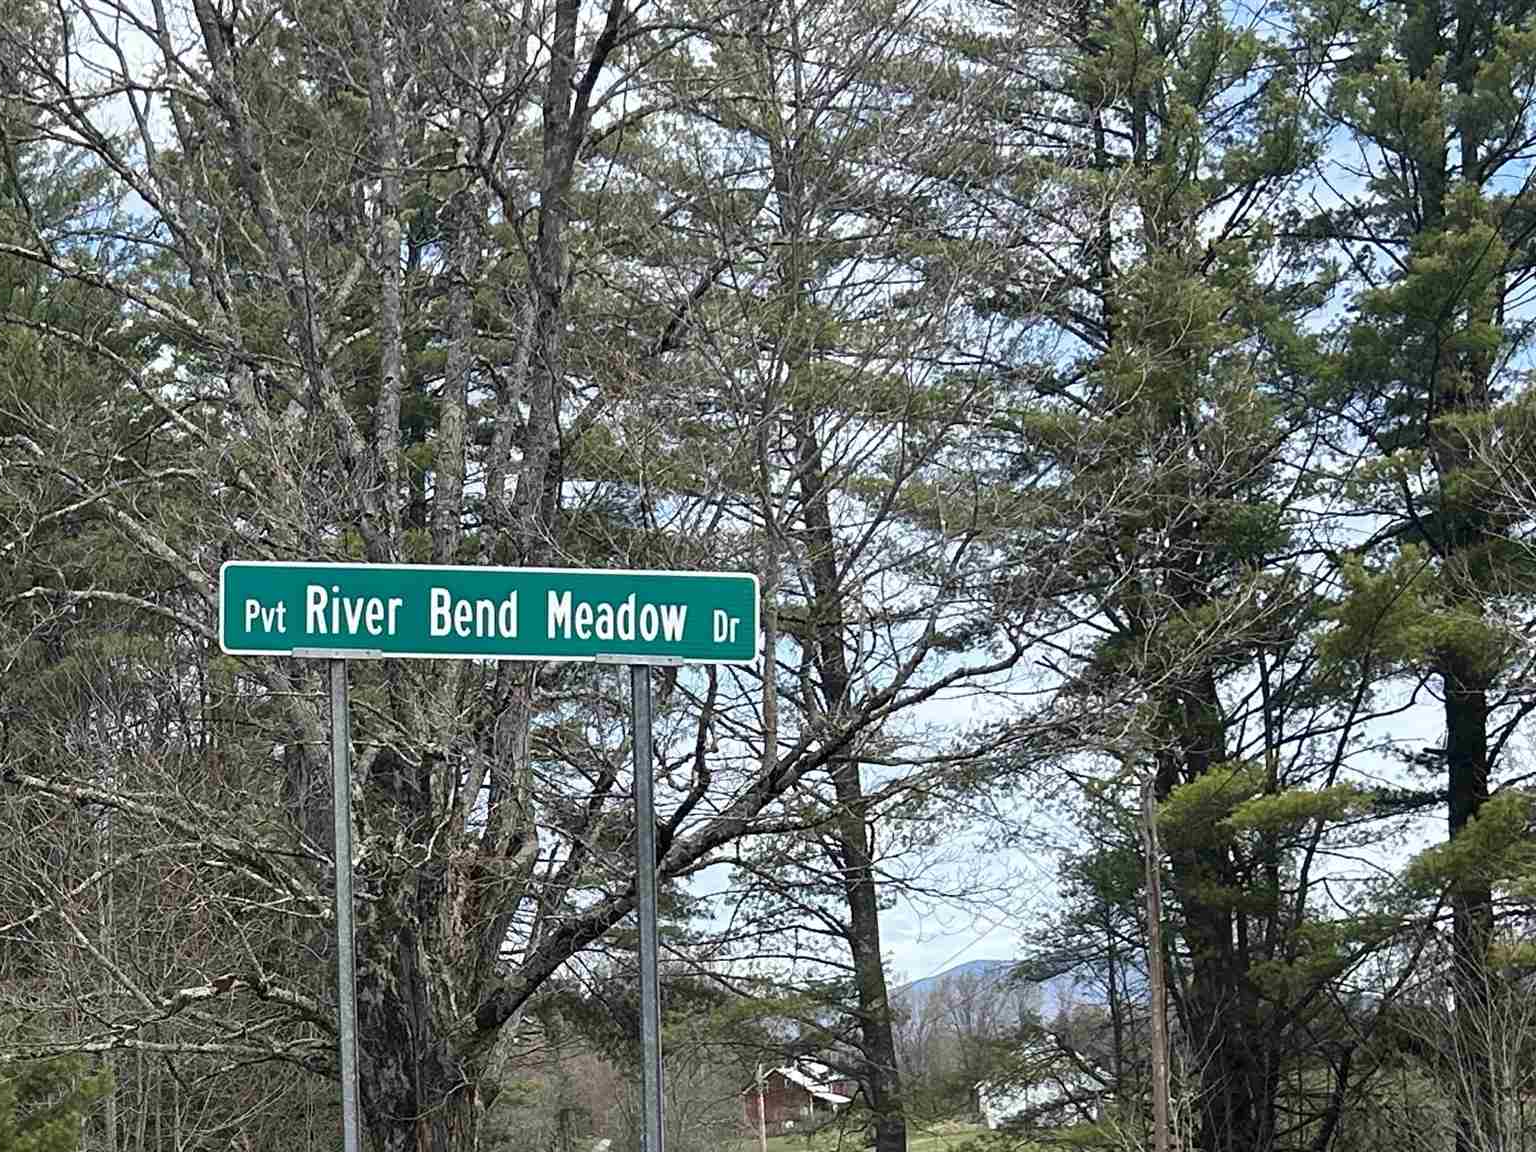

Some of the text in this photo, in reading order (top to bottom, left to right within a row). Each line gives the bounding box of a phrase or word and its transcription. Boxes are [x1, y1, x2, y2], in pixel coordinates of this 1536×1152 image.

[245, 585, 740, 643] Pvt River Bend Meadow Dr
